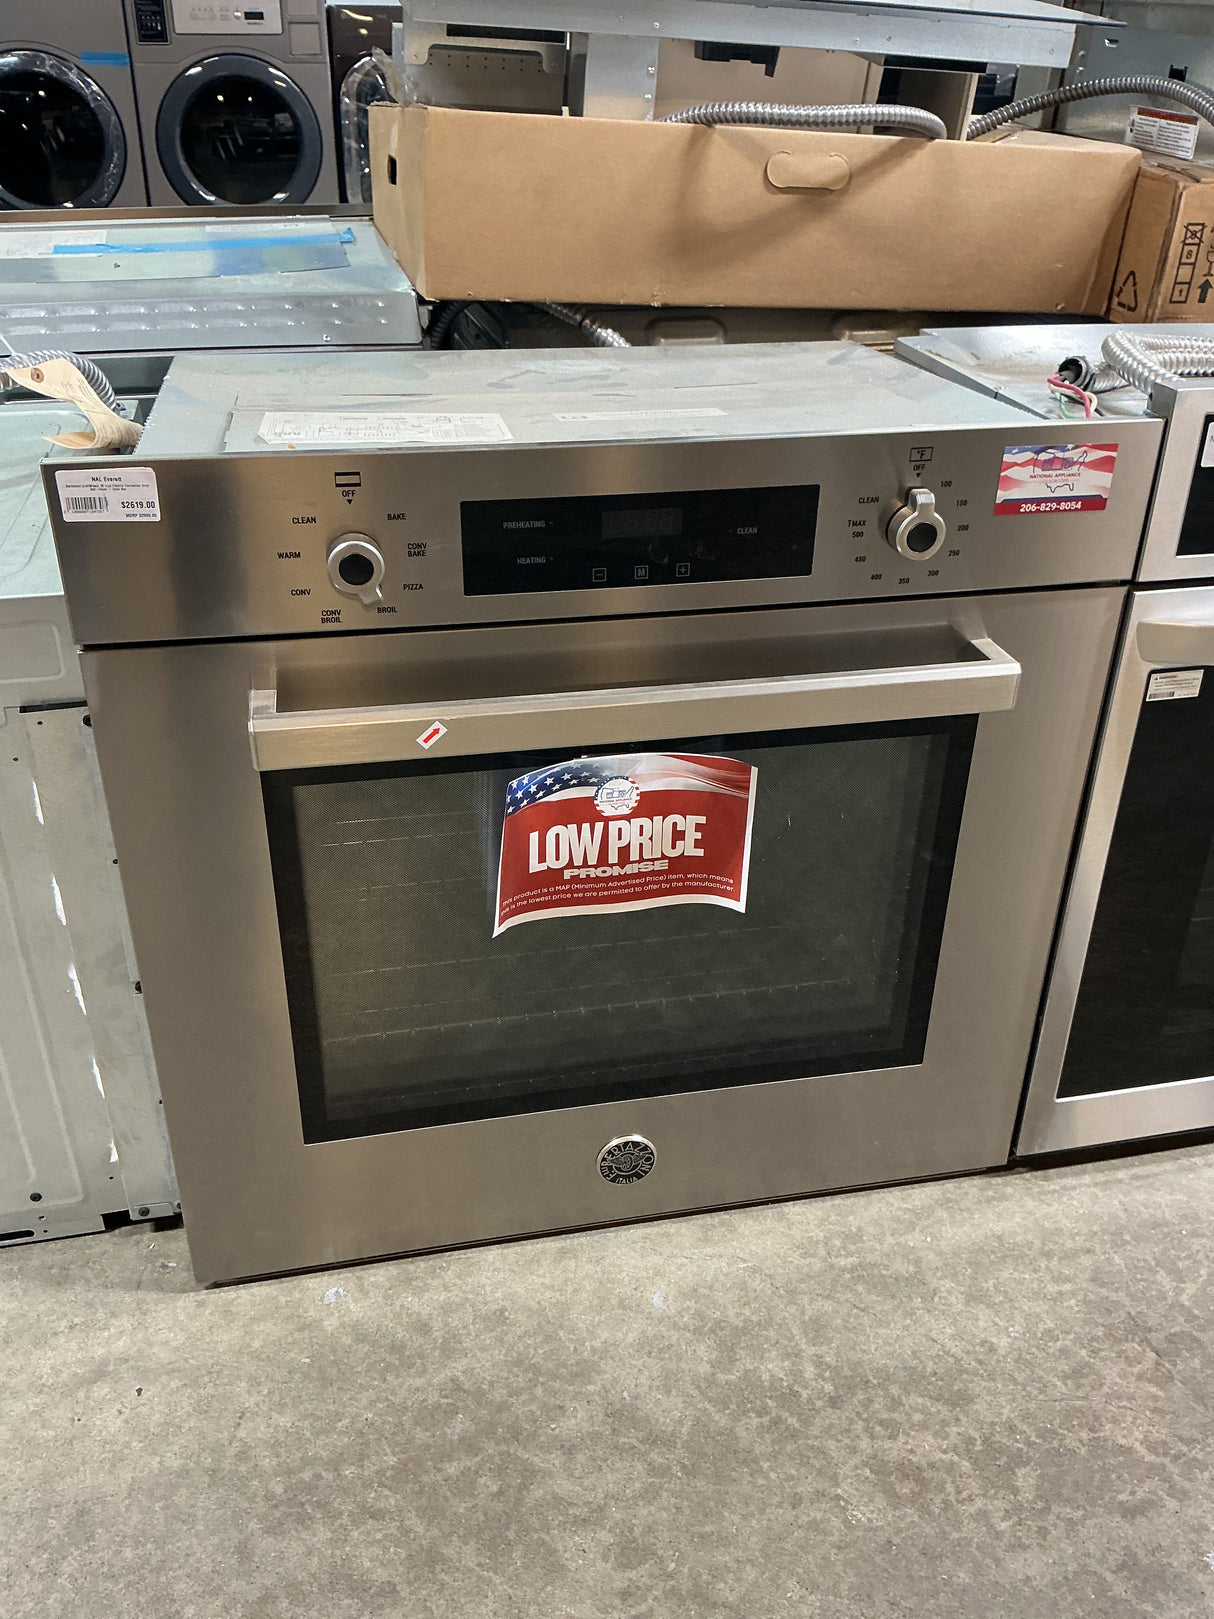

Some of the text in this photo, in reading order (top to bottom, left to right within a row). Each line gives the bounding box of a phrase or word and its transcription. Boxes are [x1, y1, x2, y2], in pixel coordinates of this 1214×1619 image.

[913, 464, 926, 472] OFF
[342, 490, 356, 498] OFF
[858, 496, 880, 504] CLEAN
[121, 501, 156, 509] $2619.00
[1020, 501, 1082, 512] 206-829-8054
[292, 516, 317, 524] CLEAN
[387, 513, 406, 521] BAKE
[502, 520, 546, 530] PREHEATING
[736, 526, 758, 535] CLEAN
[277, 552, 301, 560] WARM
[517, 556, 546, 565] HEATING
[529, 814, 706, 874] LOW PRICE
[564, 860, 668, 880] PROMISE
[514, 888, 541, 902] product
[571, 882, 607, 890] (Minimum
[608, 877, 645, 888] Advertised
[646, 874, 666, 883] Price)
[710, 874, 734, 884] means
[528, 895, 551, 904] lowest
[552, 892, 572, 900] price
[598, 887, 634, 897] permitted
[644, 883, 660, 891] offer
[684, 880, 735, 892] manufacturer.
[601, 1142, 654, 1176] BERTAZZONI
